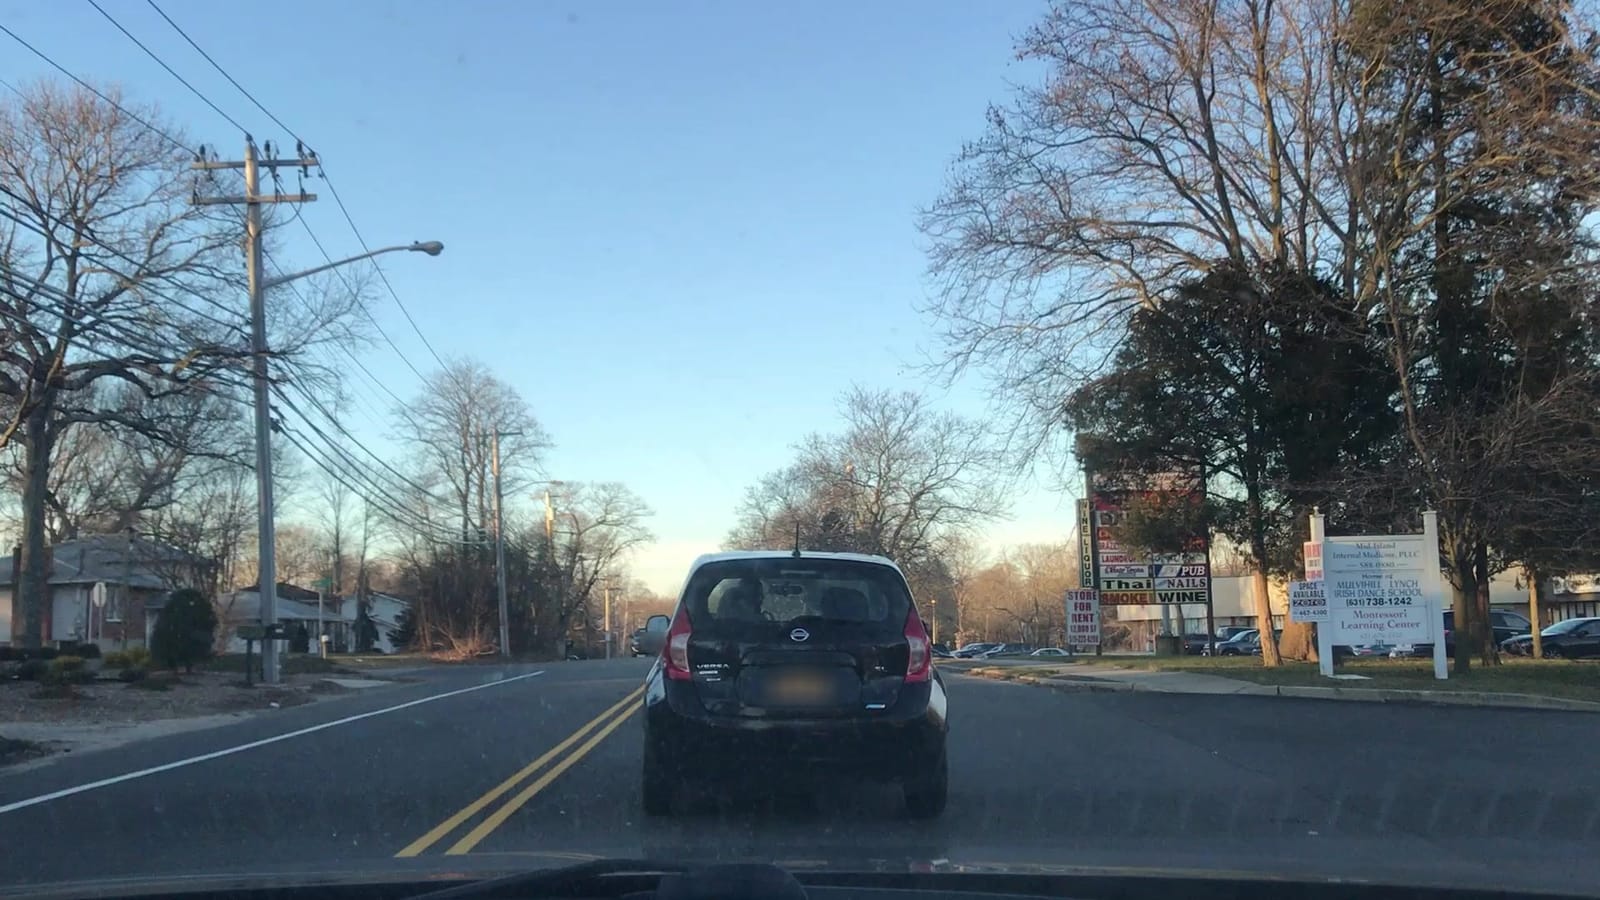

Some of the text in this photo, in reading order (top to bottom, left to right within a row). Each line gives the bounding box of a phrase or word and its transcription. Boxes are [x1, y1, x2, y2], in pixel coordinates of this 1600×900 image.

[1083, 538, 1092, 585] LIQUOR
[1181, 565, 1206, 576] PUB
[1103, 580, 1151, 589] Thai
[1167, 578, 1206, 588] NAILS
[1299, 582, 1317, 590] SPACE
[1390, 579, 1418, 588] LYNCH
[1068, 591, 1097, 600] STORE
[1102, 592, 1148, 604] SMOKE
[1158, 591, 1206, 602] WINE
[1293, 590, 1324, 598] AVAILABLE
[1335, 588, 1422, 598] IRISH DANCE SCHOOL
[1074, 602, 1091, 611] FOR
[1346, 597, 1412, 607] (631) 738-1242
[1072, 613, 1094, 623] RENT
[1354, 609, 1407, 619] Montessori
[1341, 619, 1420, 631] Learning Center
